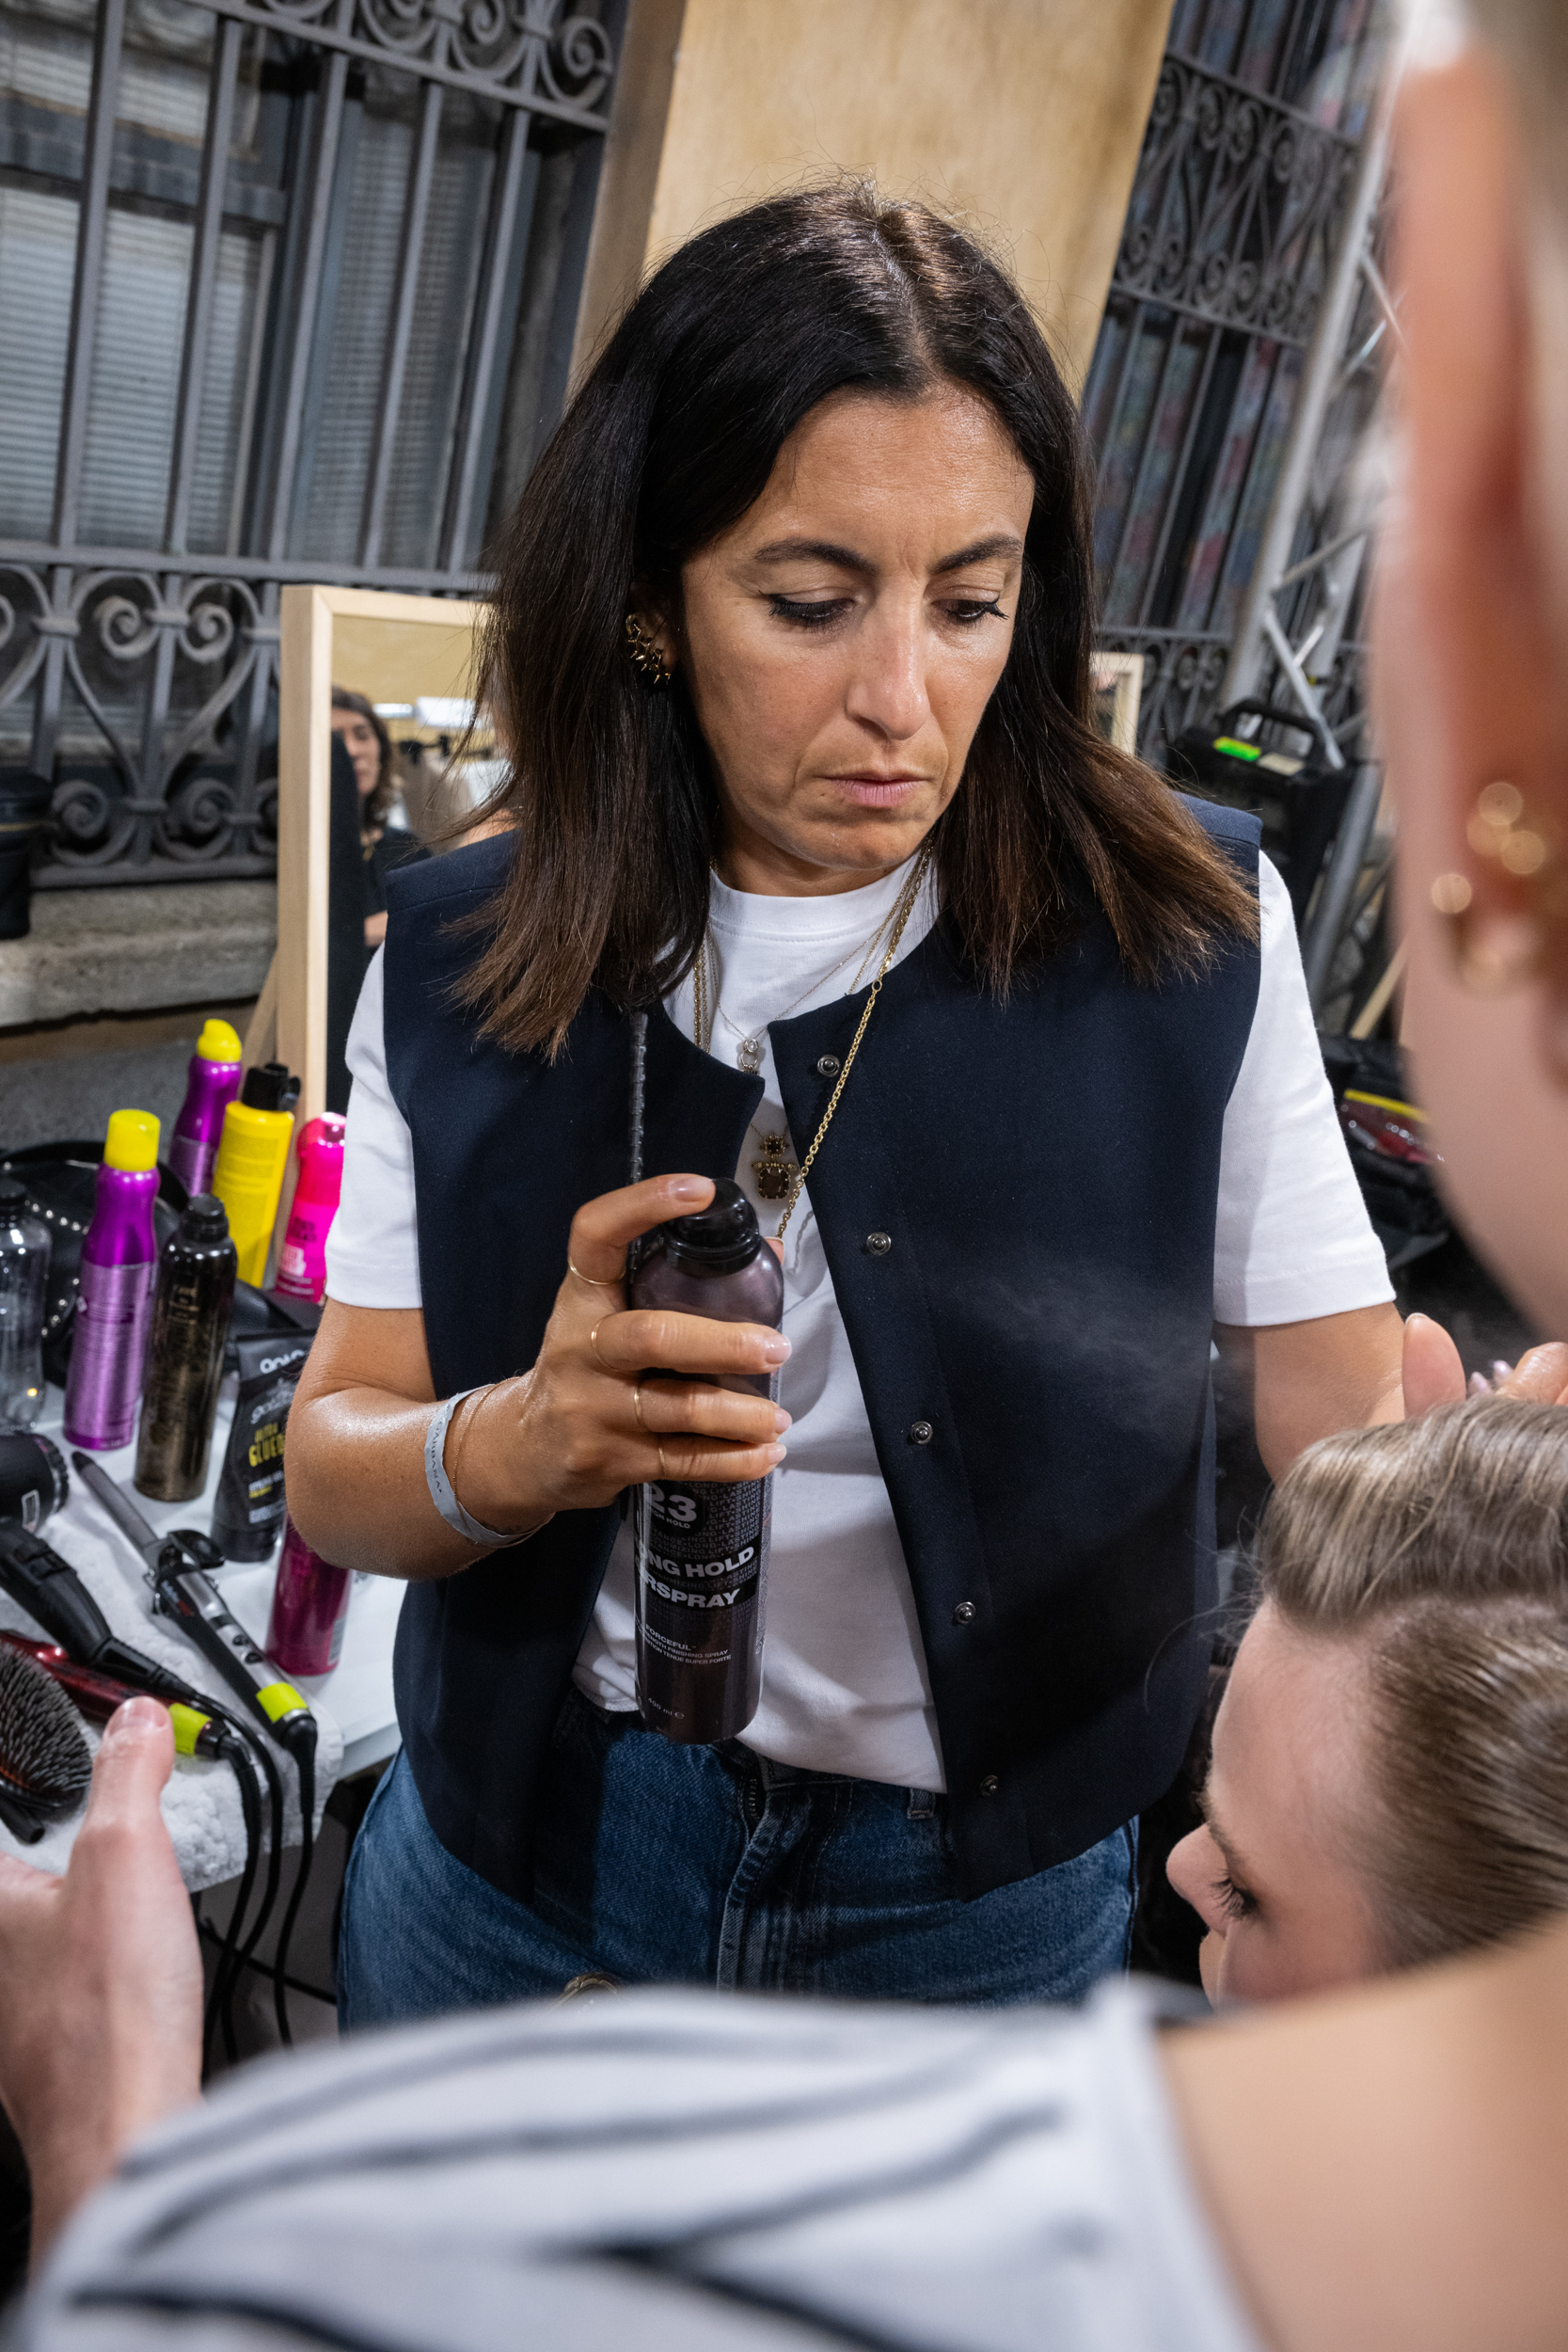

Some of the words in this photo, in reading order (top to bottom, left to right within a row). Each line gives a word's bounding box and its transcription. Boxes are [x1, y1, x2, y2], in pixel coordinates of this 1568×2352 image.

[666, 1518, 691, 1529] HOLD
[685, 1546, 754, 1578] HOLD
[644, 1569, 741, 1608] RSPRAY
[663, 1650, 685, 1662] TENUE
[709, 1654, 732, 1663] FORTE
[668, 1646, 703, 1658] FINISHING
[705, 1649, 729, 1658] SPRAY
[648, 1697, 662, 1710] 400
